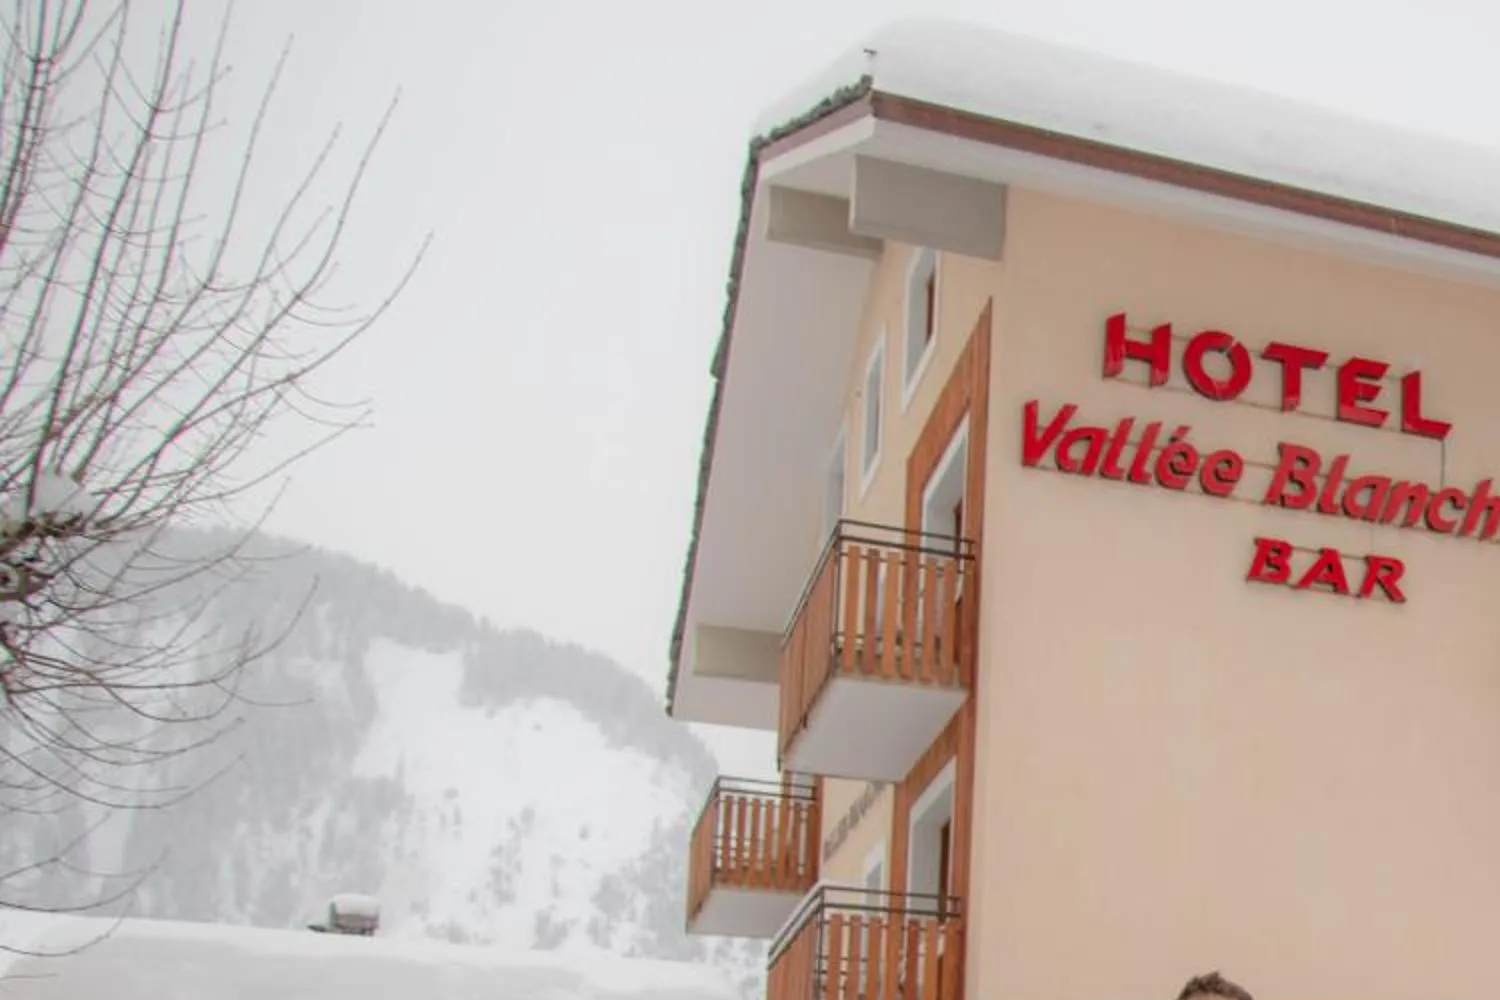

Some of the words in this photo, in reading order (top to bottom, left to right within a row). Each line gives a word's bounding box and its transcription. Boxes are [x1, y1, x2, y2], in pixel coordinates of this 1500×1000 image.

[1103, 312, 1453, 440] HOTEL
[1021, 399, 1245, 497] Vallée
[1246, 537, 1407, 602] BAR
